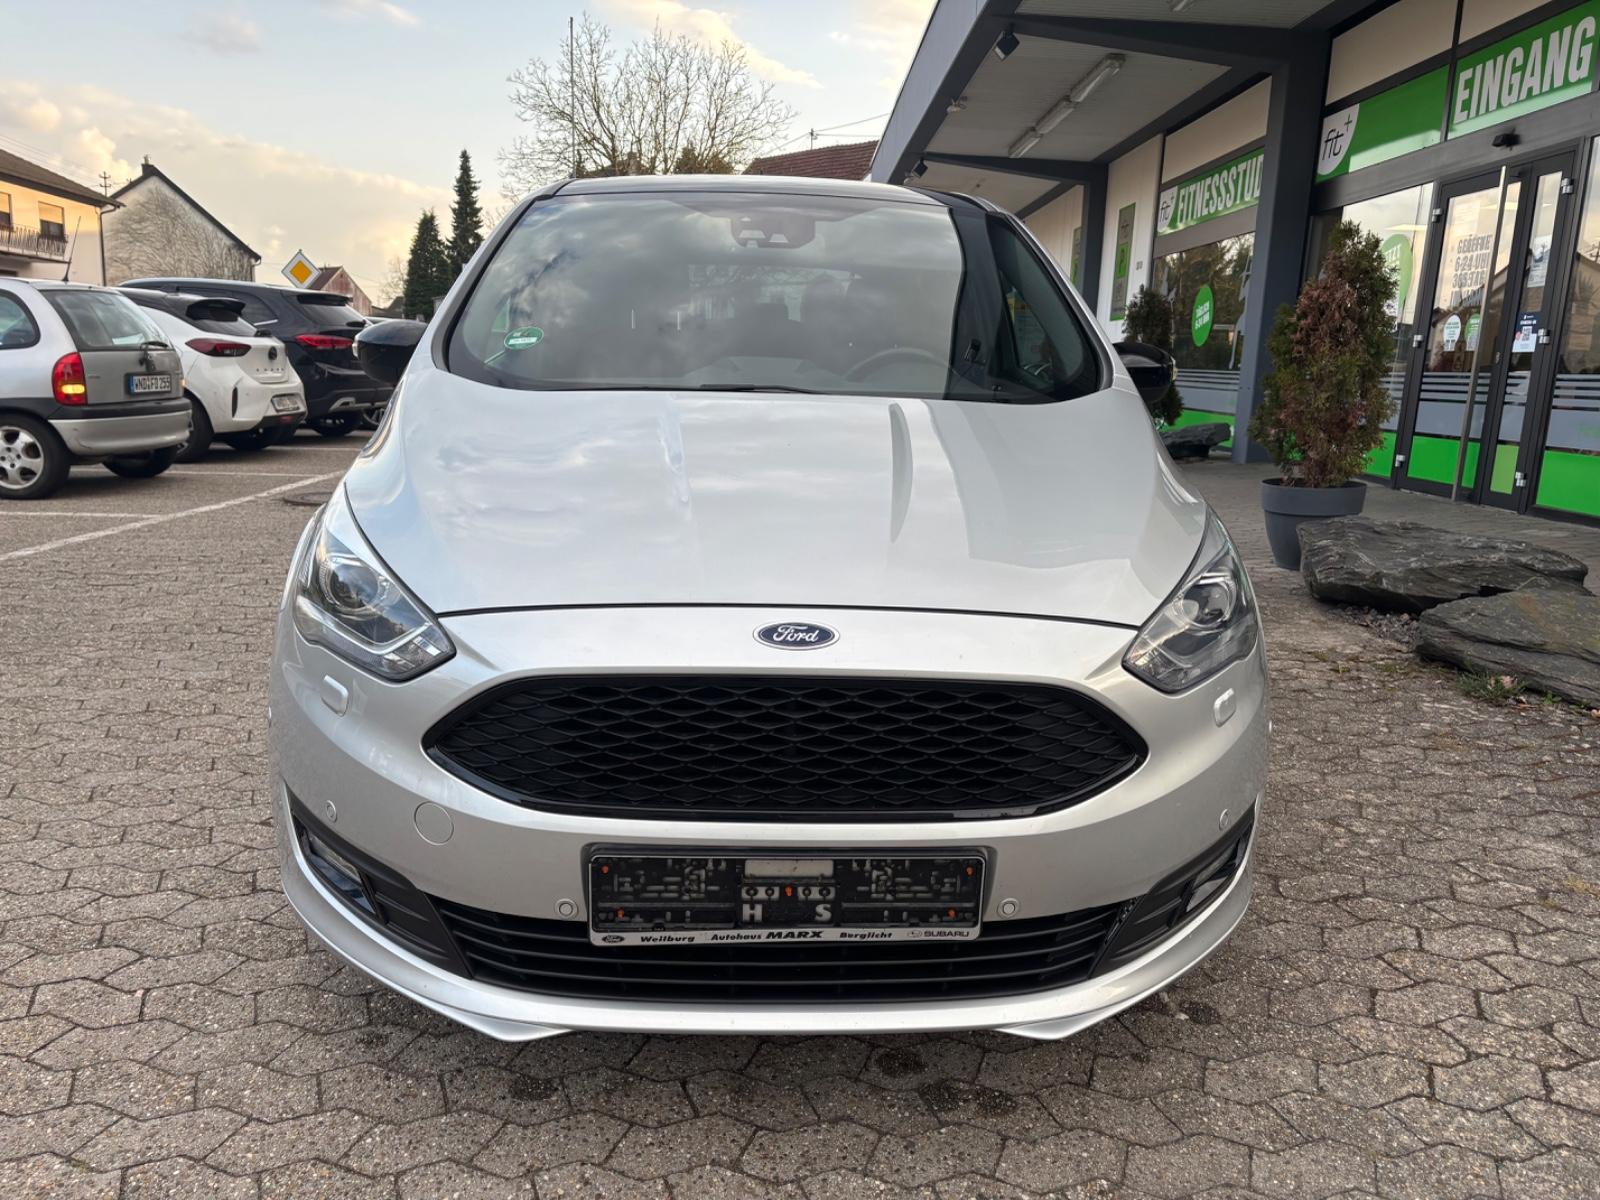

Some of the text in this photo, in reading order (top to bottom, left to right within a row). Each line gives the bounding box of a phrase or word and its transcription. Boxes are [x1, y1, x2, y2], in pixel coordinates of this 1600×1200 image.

[1453, 16, 1596, 125] EINGANG
[772, 624, 820, 642] Ford
[640, 934, 695, 943] Weilburg
[711, 932, 762, 941] Autohaus
[766, 931, 824, 940] MARX
[839, 931, 893, 939] Berglicht
[924, 930, 970, 938] SUBARU
